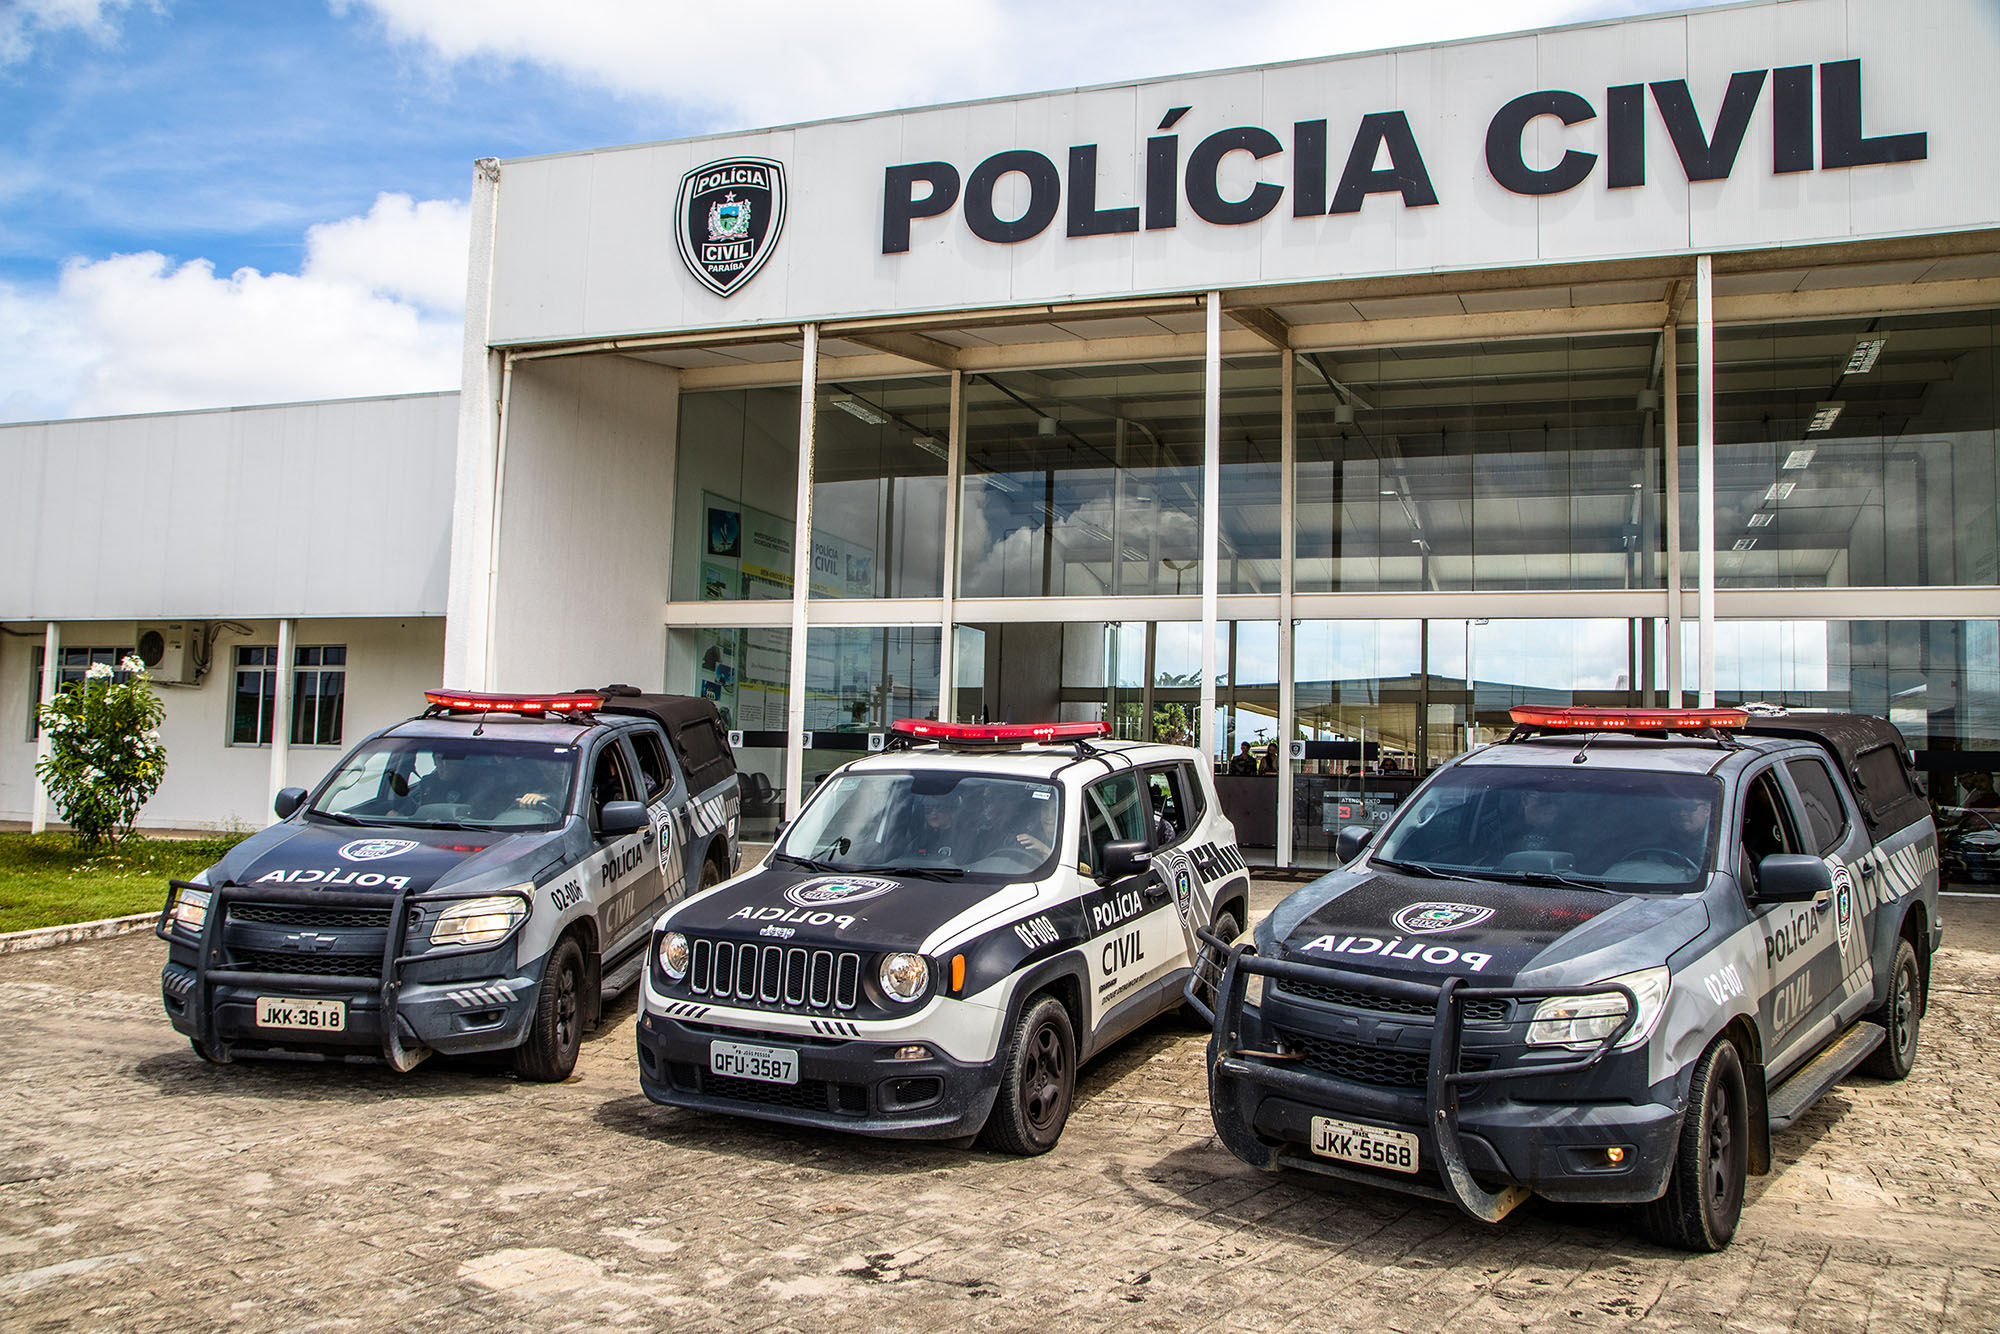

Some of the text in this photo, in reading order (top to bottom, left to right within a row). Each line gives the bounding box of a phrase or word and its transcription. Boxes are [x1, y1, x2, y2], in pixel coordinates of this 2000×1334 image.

[882, 58, 1928, 255] POLÍCIA CIVIL
[698, 167, 765, 193] POLÍCIA
[706, 244, 749, 261] CIVIL
[707, 262, 745, 272] PARAÍBA
[815, 543, 838, 560] POLÍCIA
[815, 556, 838, 576] CIVIL
[601, 843, 643, 888] POLÍCIA
[550, 879, 584, 912] 02-006
[605, 890, 636, 933] CIVIL
[1092, 890, 1143, 931] POLÍCIA
[759, 924, 796, 939] Jeep
[1014, 915, 1060, 949] 01-009
[1764, 906, 1820, 970] POLÍCIA
[1102, 930, 1144, 976] CIVIL
[1703, 963, 1744, 1006] 02-007
[1772, 969, 1813, 1031] CIVIL
